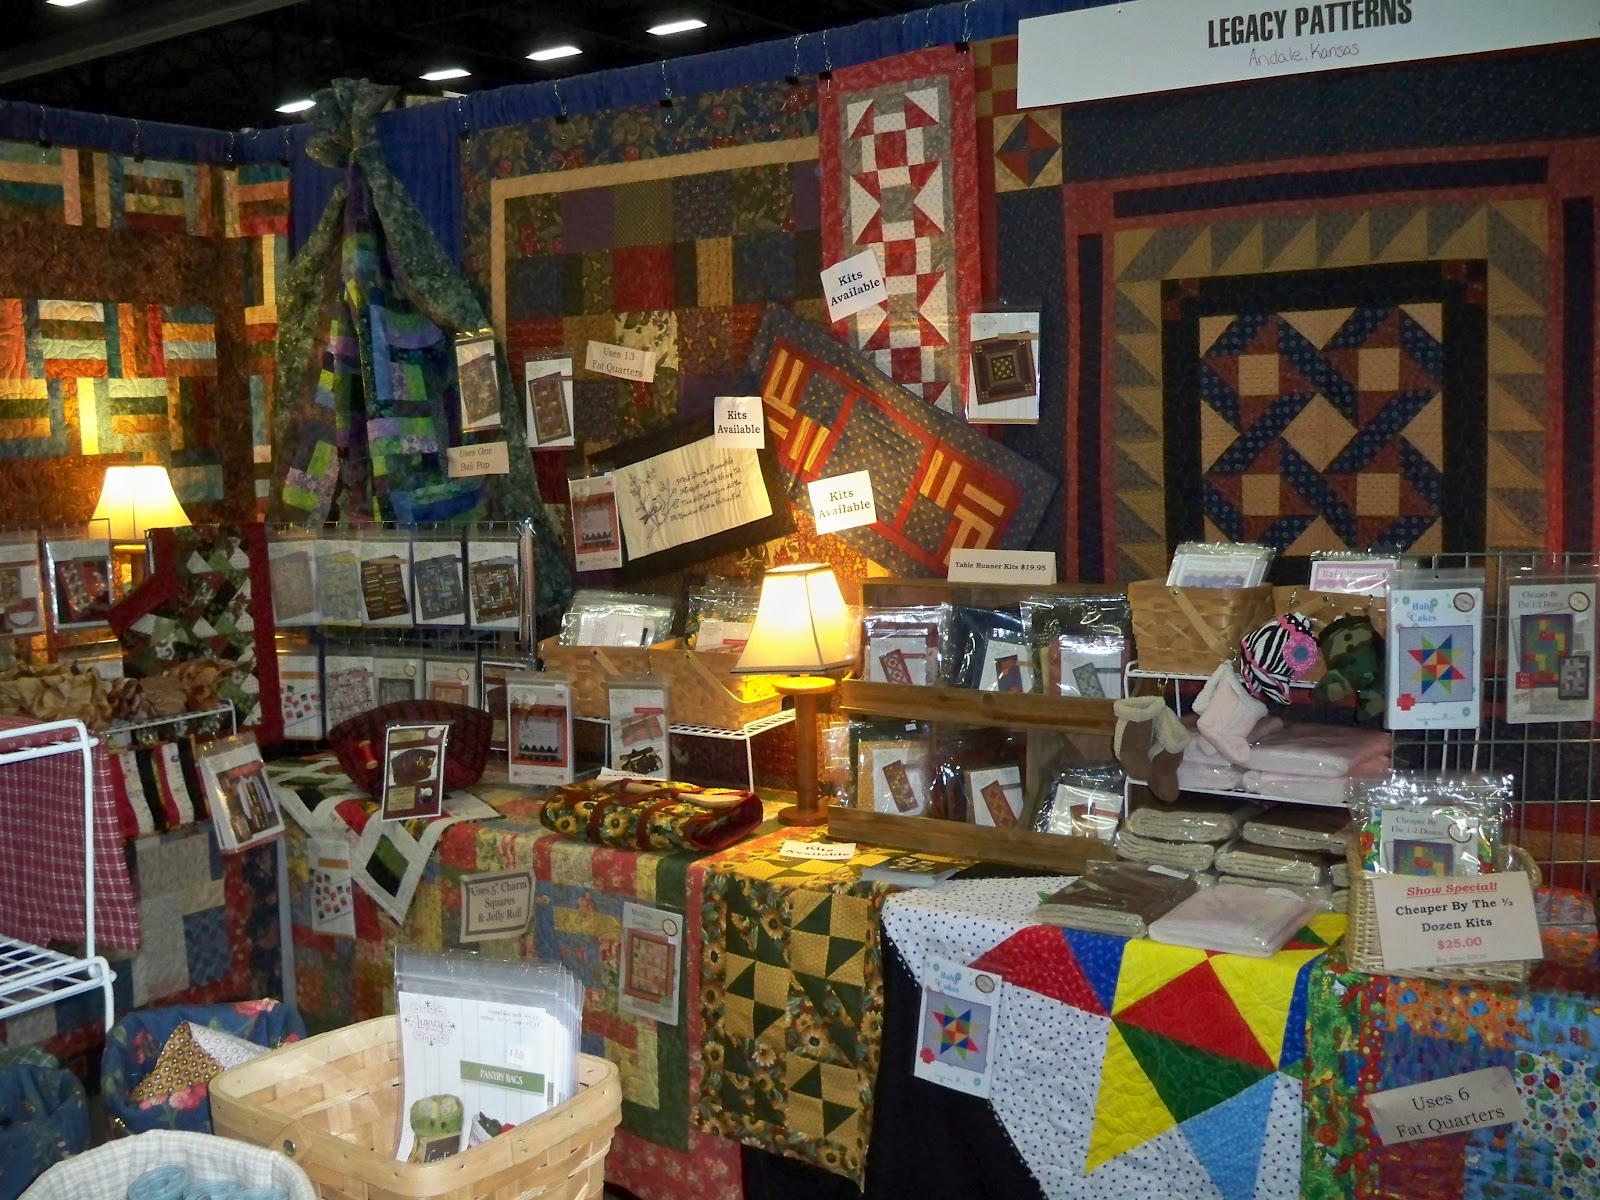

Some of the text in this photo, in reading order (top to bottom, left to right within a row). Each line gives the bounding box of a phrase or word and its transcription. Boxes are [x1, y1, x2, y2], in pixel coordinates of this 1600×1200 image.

[1208, 0, 1413, 48] LEGACY PATTERNS
[1310, 43, 1361, 60] Kansas
[838, 270, 864, 287] Kits
[830, 277, 882, 306] Available
[603, 346, 635, 361] Uses 13
[592, 359, 643, 378] Fat Quarters
[727, 410, 748, 420] Kits
[717, 423, 761, 434] Available
[477, 447, 493, 456] One
[476, 461, 490, 471] Pop
[829, 490, 855, 502] Kits
[818, 501, 871, 519] Available
[955, 561, 1046, 571] Table Runner Kits $19.95
[1410, 613, 1437, 622] Cakes
[500, 881, 528, 893] Charm
[1406, 882, 1498, 897] Show Special!
[484, 897, 516, 910] Squares
[1395, 903, 1448, 916] Cheaper
[1451, 901, 1468, 912] By
[1472, 898, 1497, 909] The
[486, 910, 505, 923] Jelly
[506, 907, 522, 919] Roll
[1421, 917, 1492, 932] Dozen Kits
[1437, 936, 1483, 950] $25.00
[937, 981, 960, 993] Cakes
[417, 1014, 444, 1033] Legacy
[480, 1069, 524, 1085] PANTRY BAGS
[1411, 1087, 1470, 1111] Uses 6
[1396, 1106, 1506, 1138] Fat Quarters
